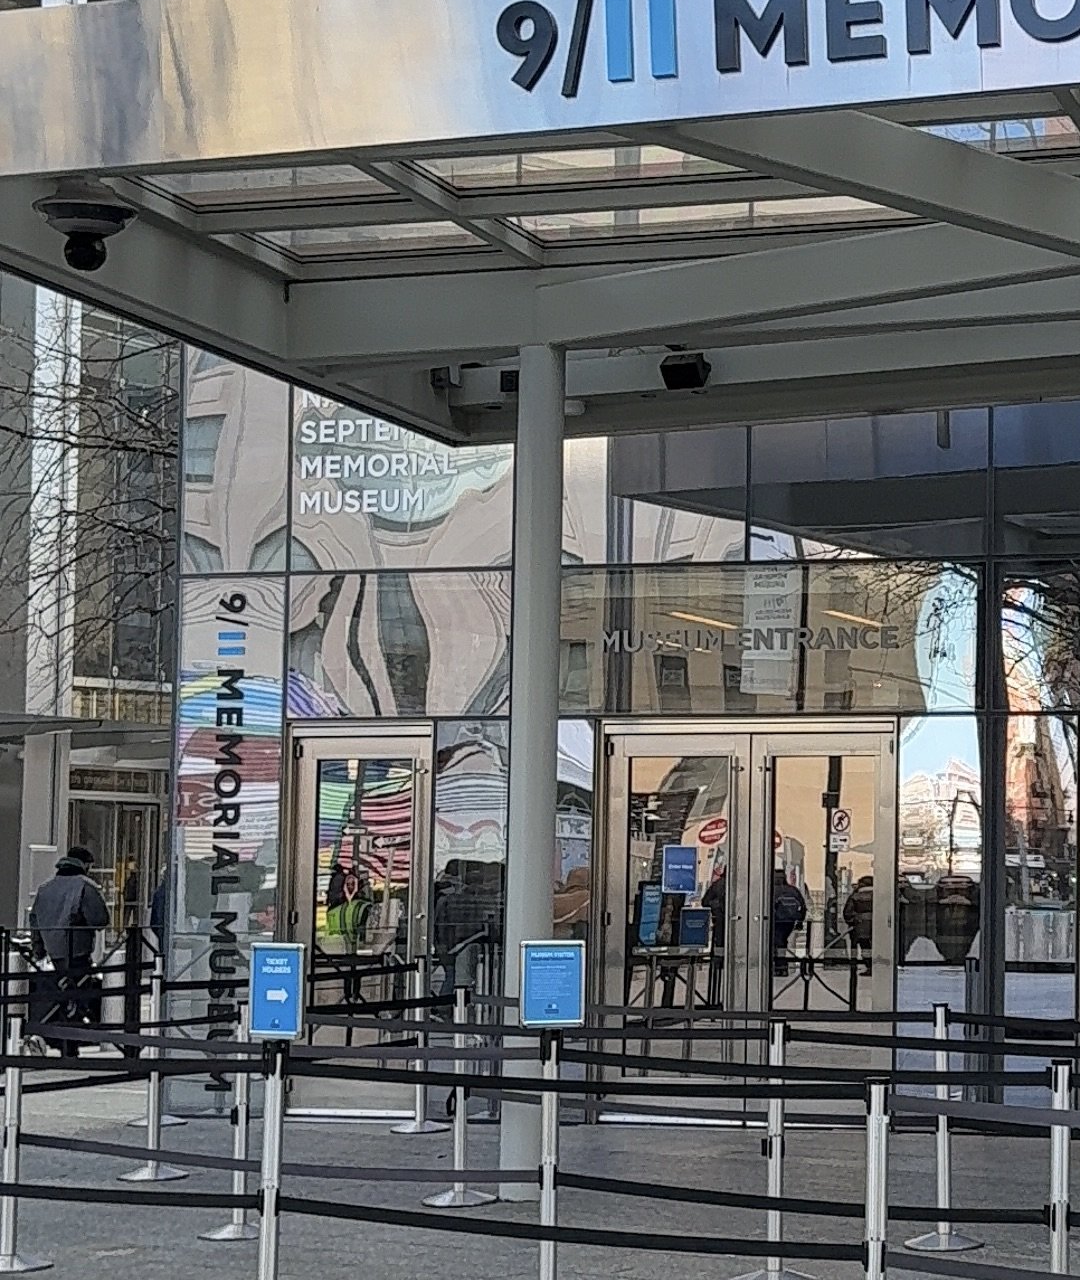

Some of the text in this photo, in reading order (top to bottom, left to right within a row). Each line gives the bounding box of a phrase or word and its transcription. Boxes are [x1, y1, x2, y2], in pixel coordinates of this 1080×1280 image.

[300, 452, 458, 480] MEMORIAL
[299, 488, 425, 515] MUSEUM
[216, 592, 249, 656] 9/11
[602, 626, 900, 654] MUSEUM ENTRANCE
[211, 668, 245, 896] MEMORIAL
